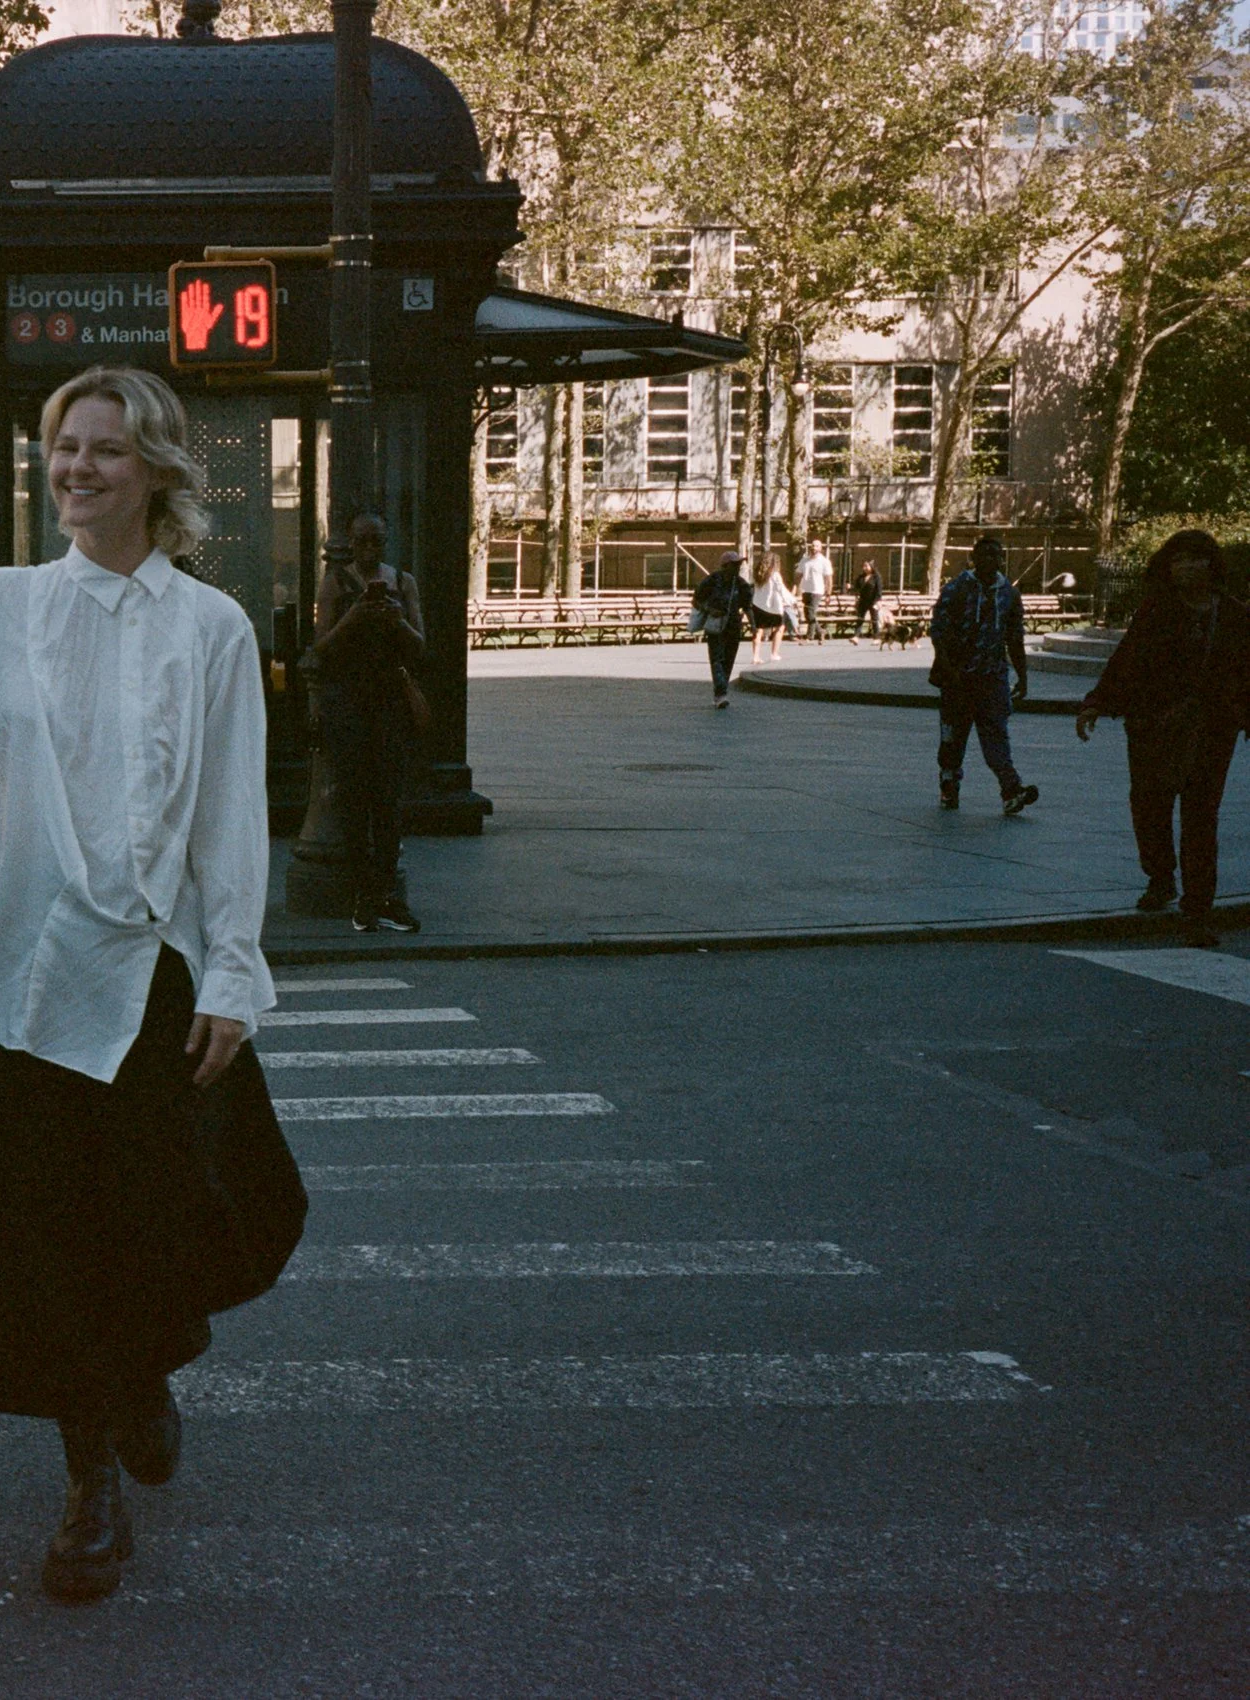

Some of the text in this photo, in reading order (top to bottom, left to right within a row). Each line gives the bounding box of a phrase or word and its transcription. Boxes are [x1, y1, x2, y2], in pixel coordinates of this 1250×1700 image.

[7, 283, 124, 312] Borough
[19, 319, 32, 337] 2
[54, 318, 67, 336] 3
[81, 327, 95, 343] &
[234, 284, 269, 348] 19
